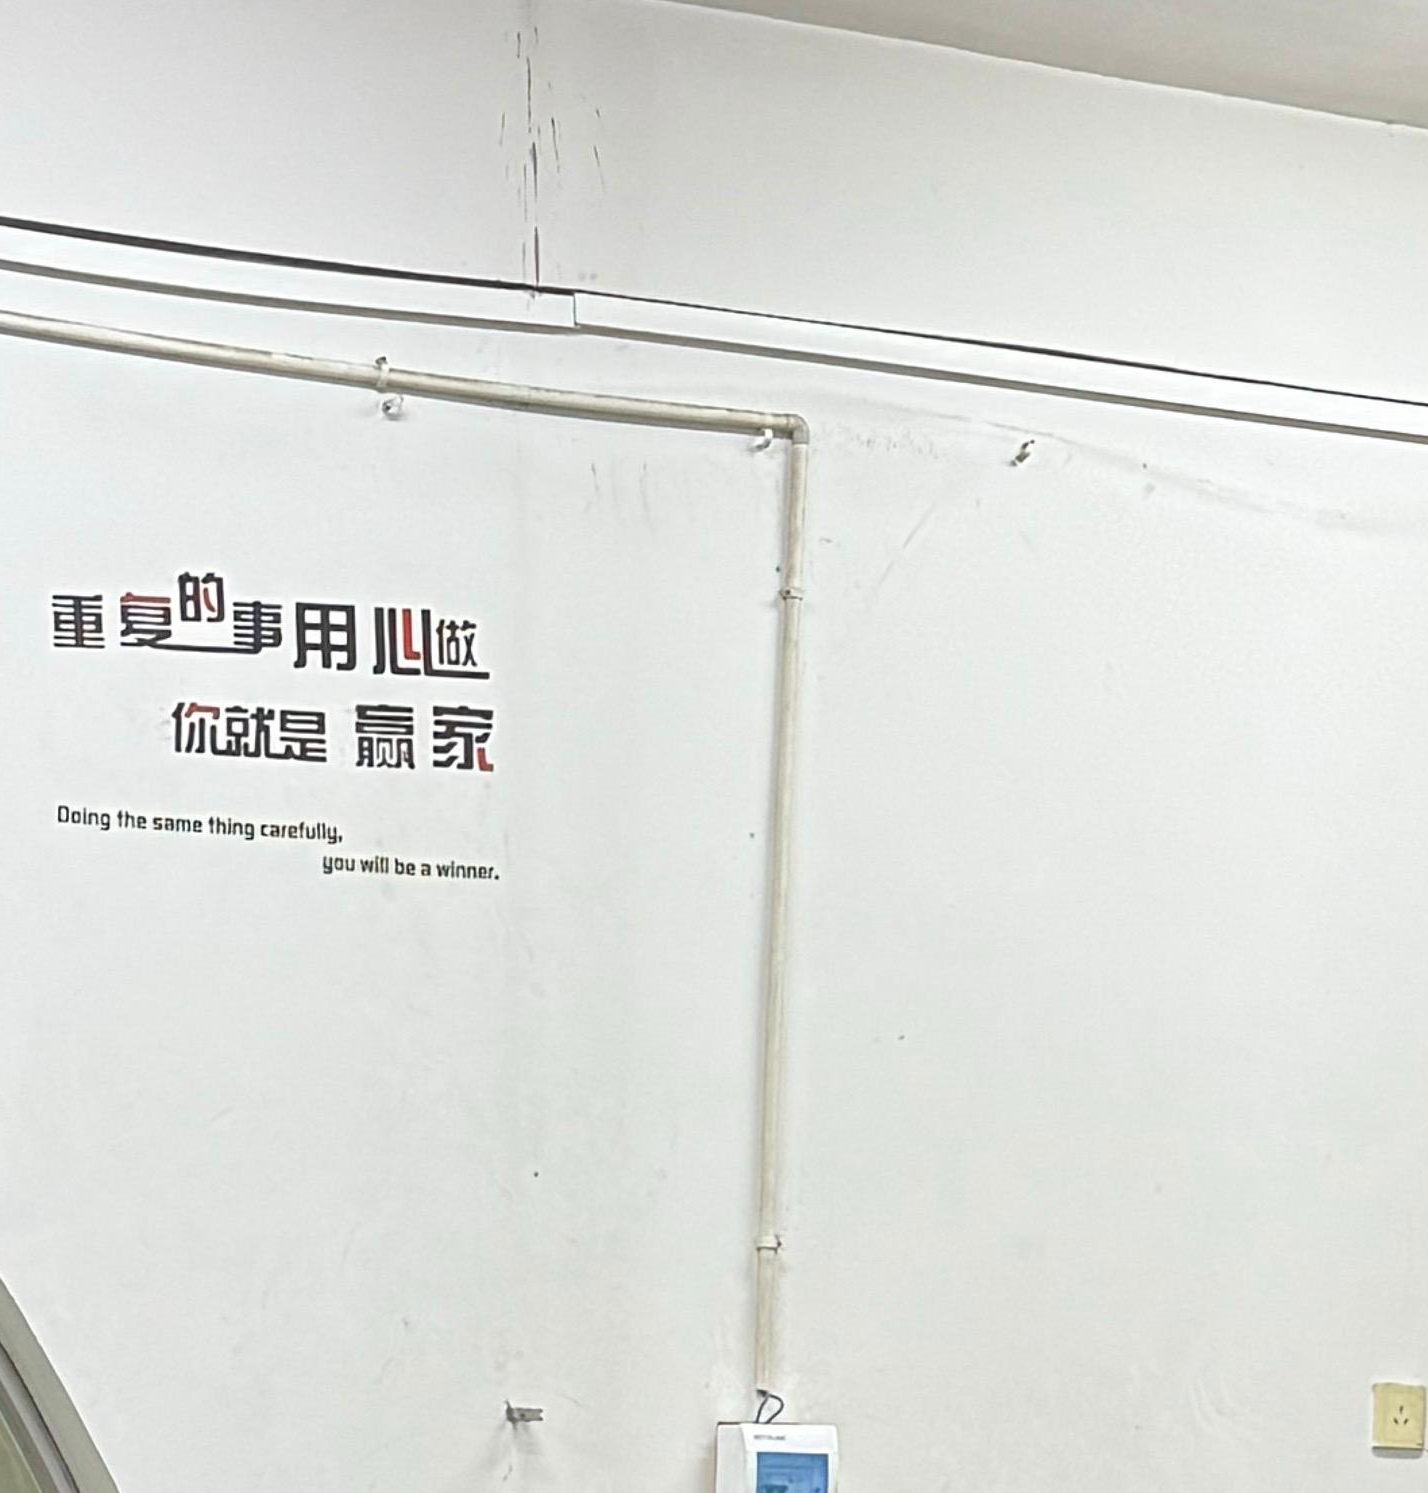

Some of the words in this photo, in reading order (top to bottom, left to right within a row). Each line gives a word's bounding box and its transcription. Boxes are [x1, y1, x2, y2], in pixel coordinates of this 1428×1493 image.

[51, 571, 490, 680] 重复的事用心做
[57, 805, 111, 831] Doing
[116, 810, 147, 830] the
[152, 816, 203, 833] same
[208, 816, 255, 841] thing
[260, 821, 343, 845] carefully,
[322, 856, 356, 875] you
[359, 855, 390, 874] will
[394, 857, 416, 877] be
[420, 863, 432, 877] a
[436, 860, 500, 881] winner.
